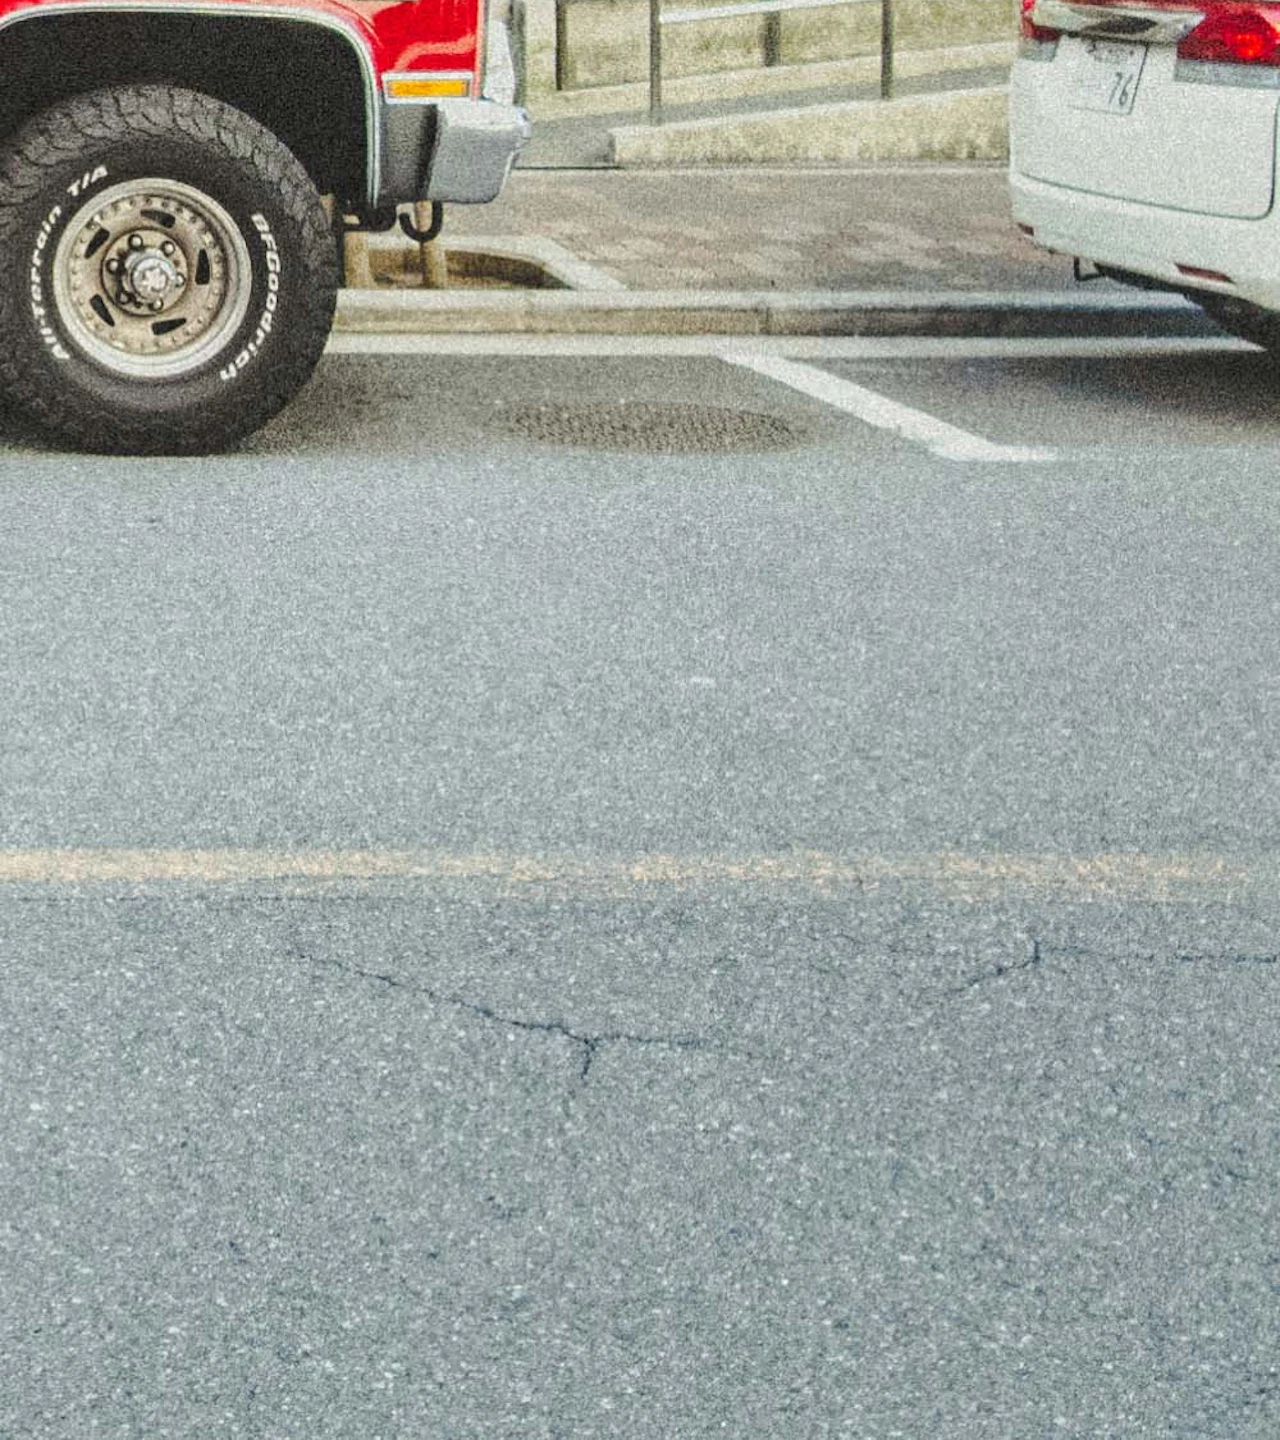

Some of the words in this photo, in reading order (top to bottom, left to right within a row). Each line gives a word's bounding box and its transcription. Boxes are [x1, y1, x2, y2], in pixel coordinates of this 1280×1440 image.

[31, 206, 71, 361] All-Terrain
[66, 165, 108, 197] T/A
[220, 212, 282, 381] BFGoodrich
